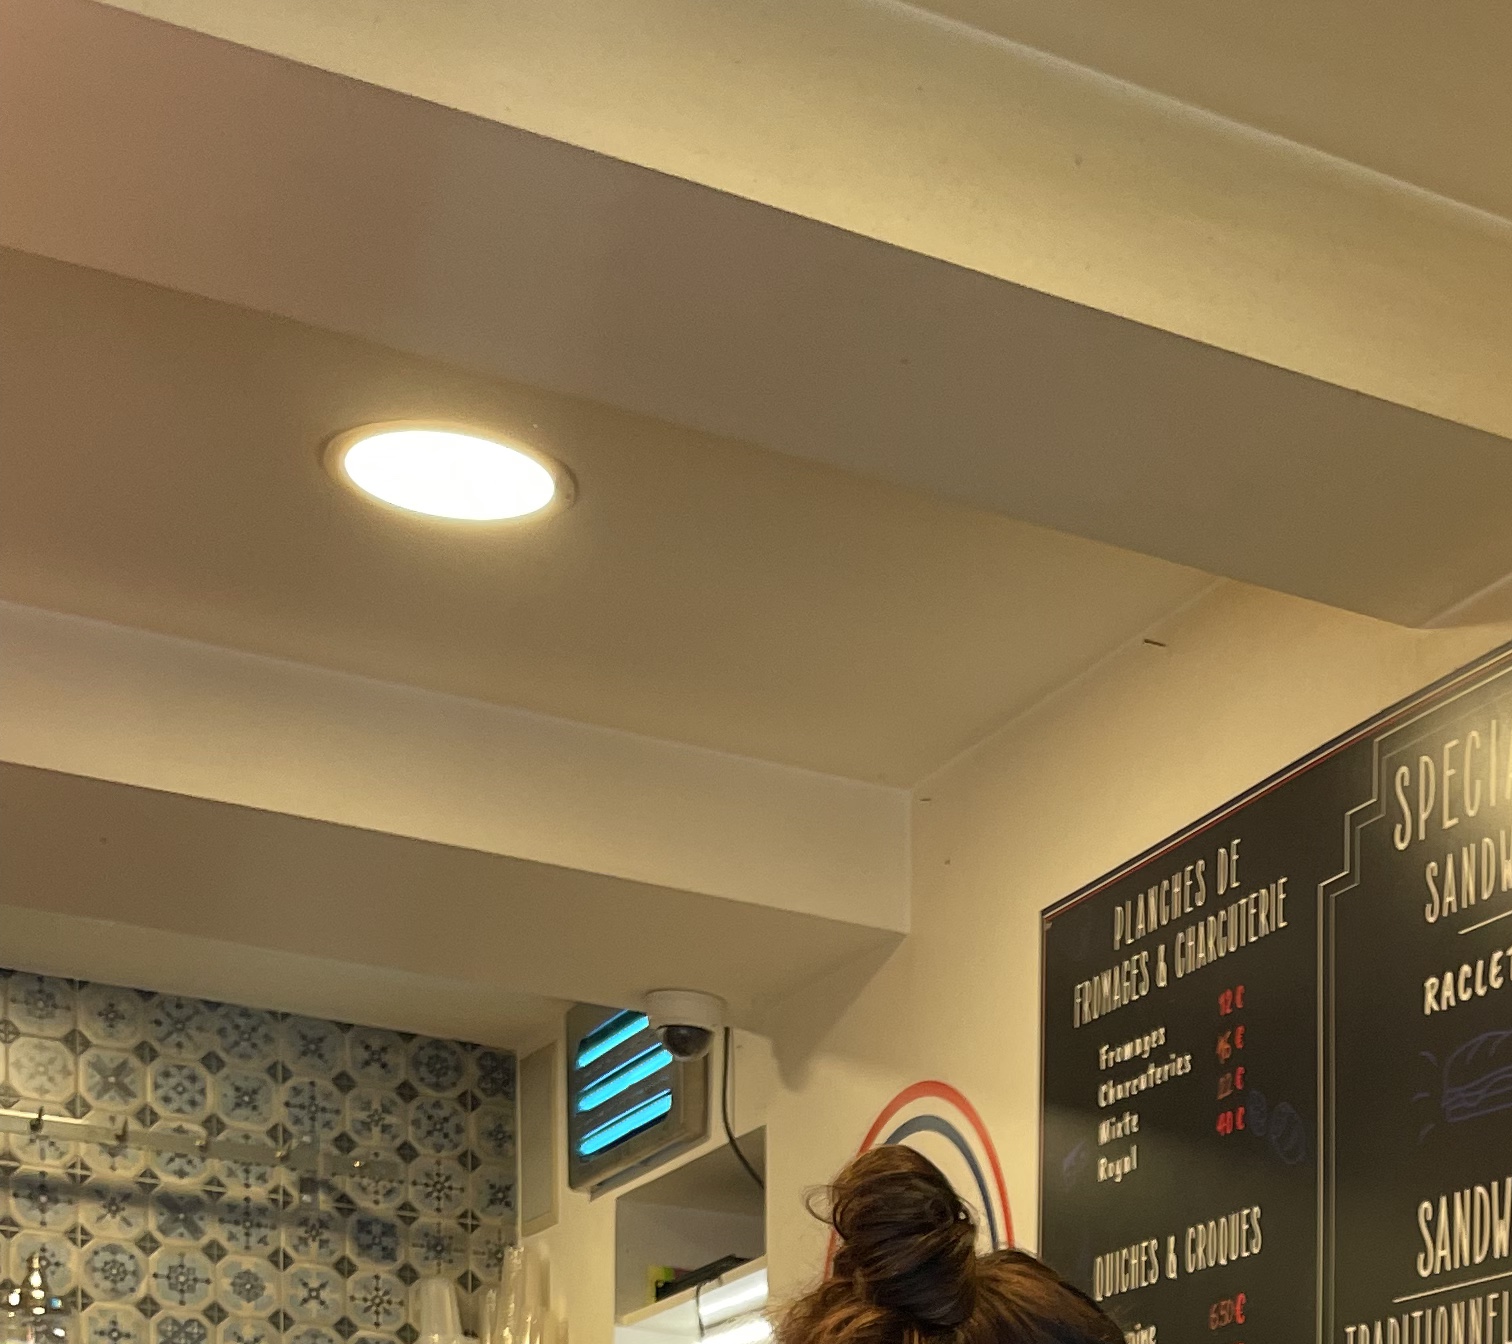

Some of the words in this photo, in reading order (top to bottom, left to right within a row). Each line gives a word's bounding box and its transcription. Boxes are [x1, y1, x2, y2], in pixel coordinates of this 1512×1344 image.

[1113, 859, 1206, 950] PLANCHES
[1217, 838, 1242, 895] DE
[1073, 950, 1150, 1028] FROMAGES
[1156, 944, 1168, 988] &
[1174, 876, 1288, 978] CHARCUTERIE
[1099, 1027, 1166, 1070] Fromages
[1098, 1111, 1140, 1146] Mixte
[1097, 1144, 1138, 1183] Royal
[1093, 1238, 1159, 1301] QUICHES
[1165, 1235, 1178, 1280] &
[1185, 1205, 1263, 1275] CROQUES
